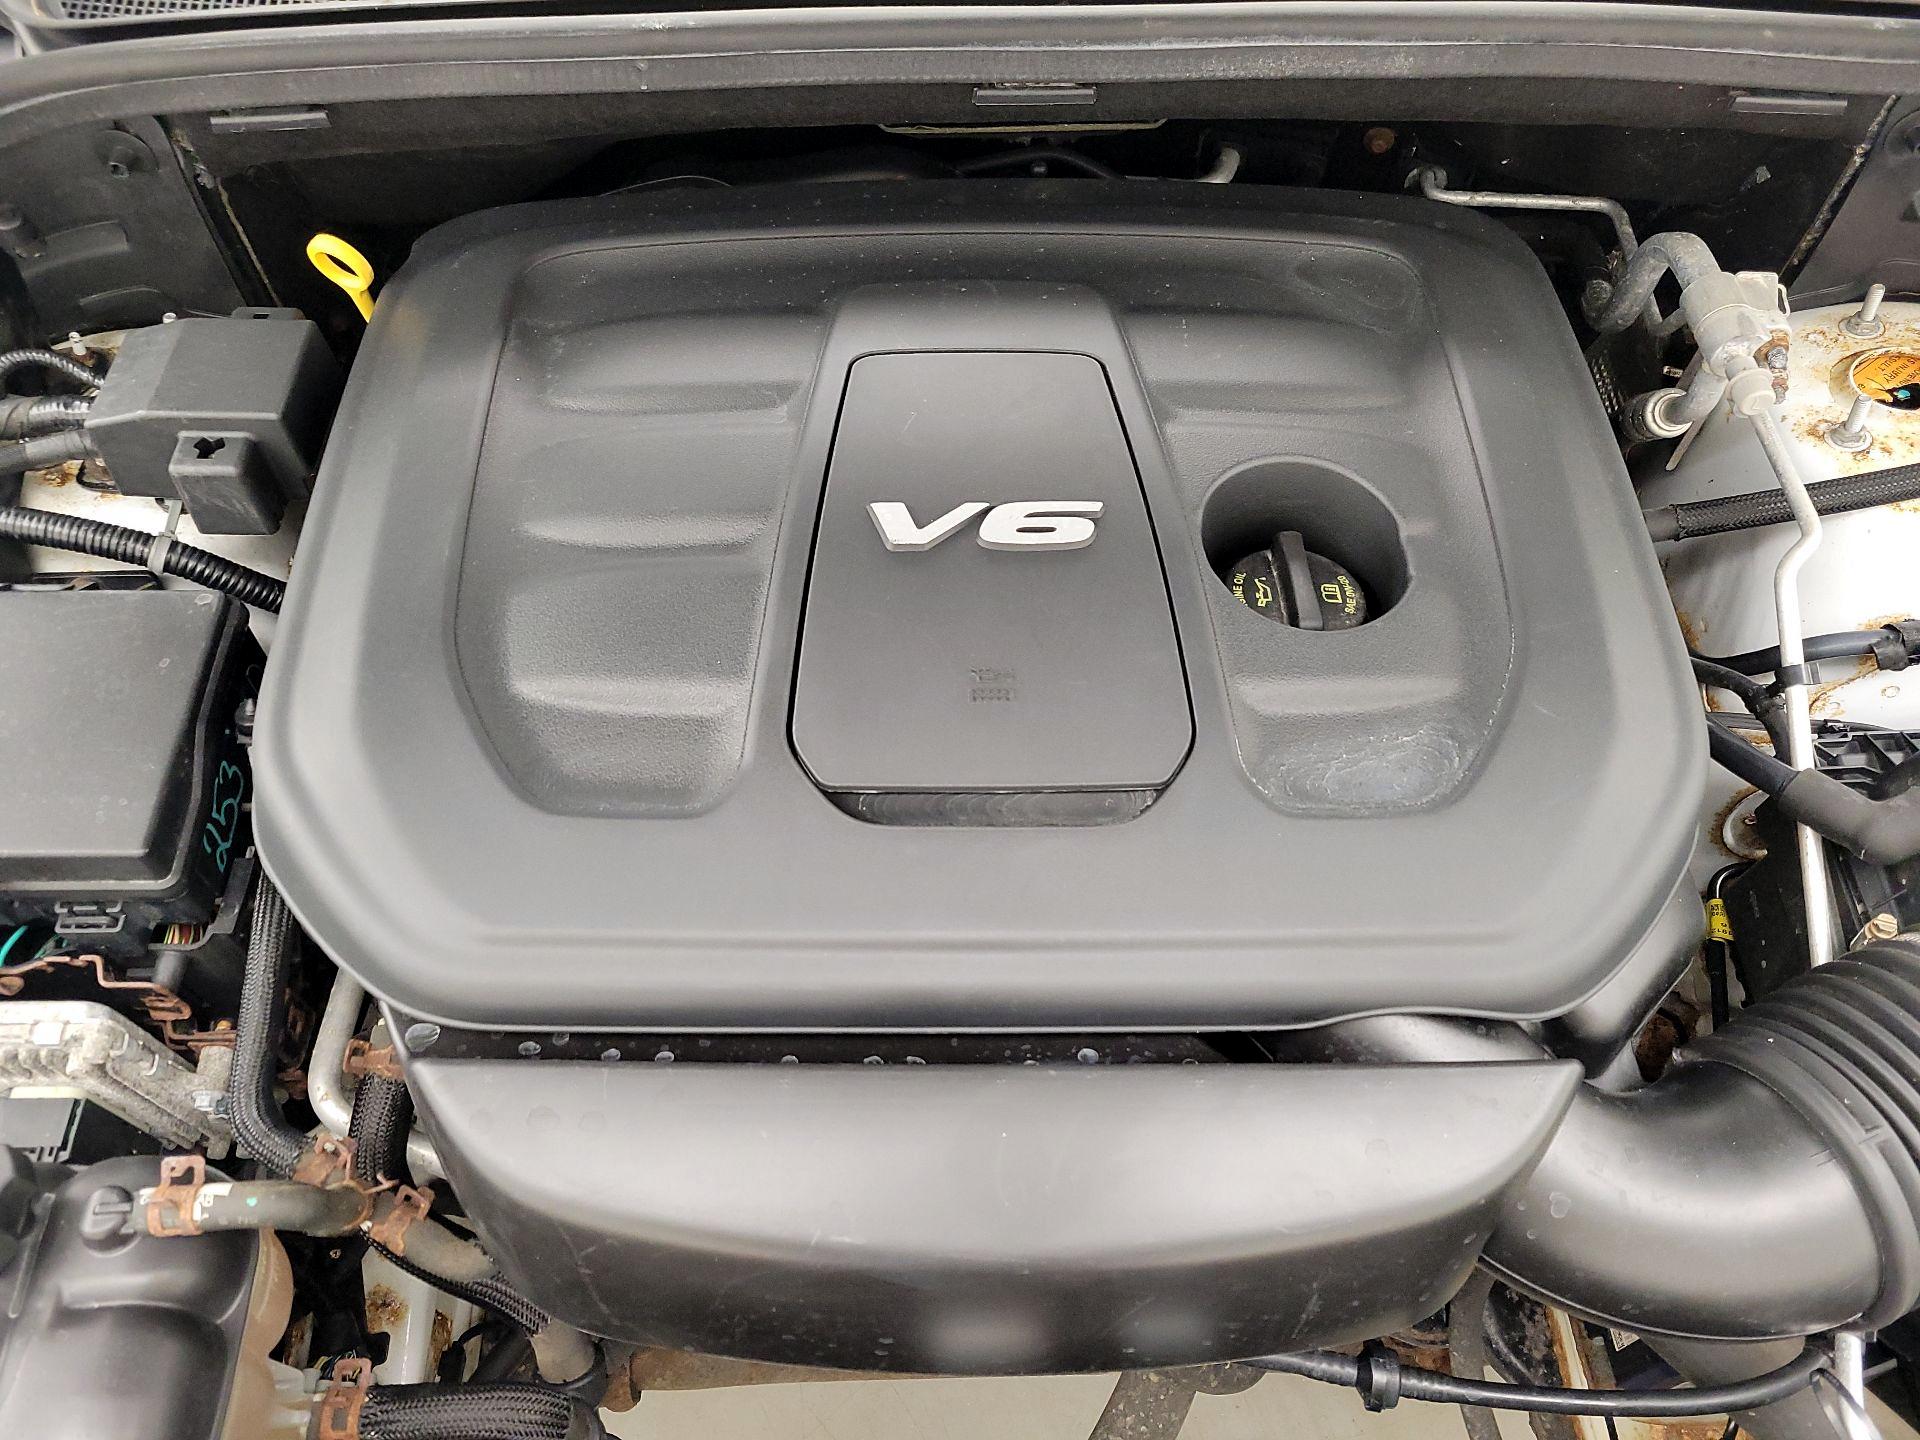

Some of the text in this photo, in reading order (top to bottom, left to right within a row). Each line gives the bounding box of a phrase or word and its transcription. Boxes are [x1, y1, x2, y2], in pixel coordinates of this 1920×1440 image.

[866, 499, 1106, 552] V6
[1232, 572, 1248, 607] GINE OIL
[1344, 597, 1357, 615] SAE
[203, 760, 244, 873] 253
